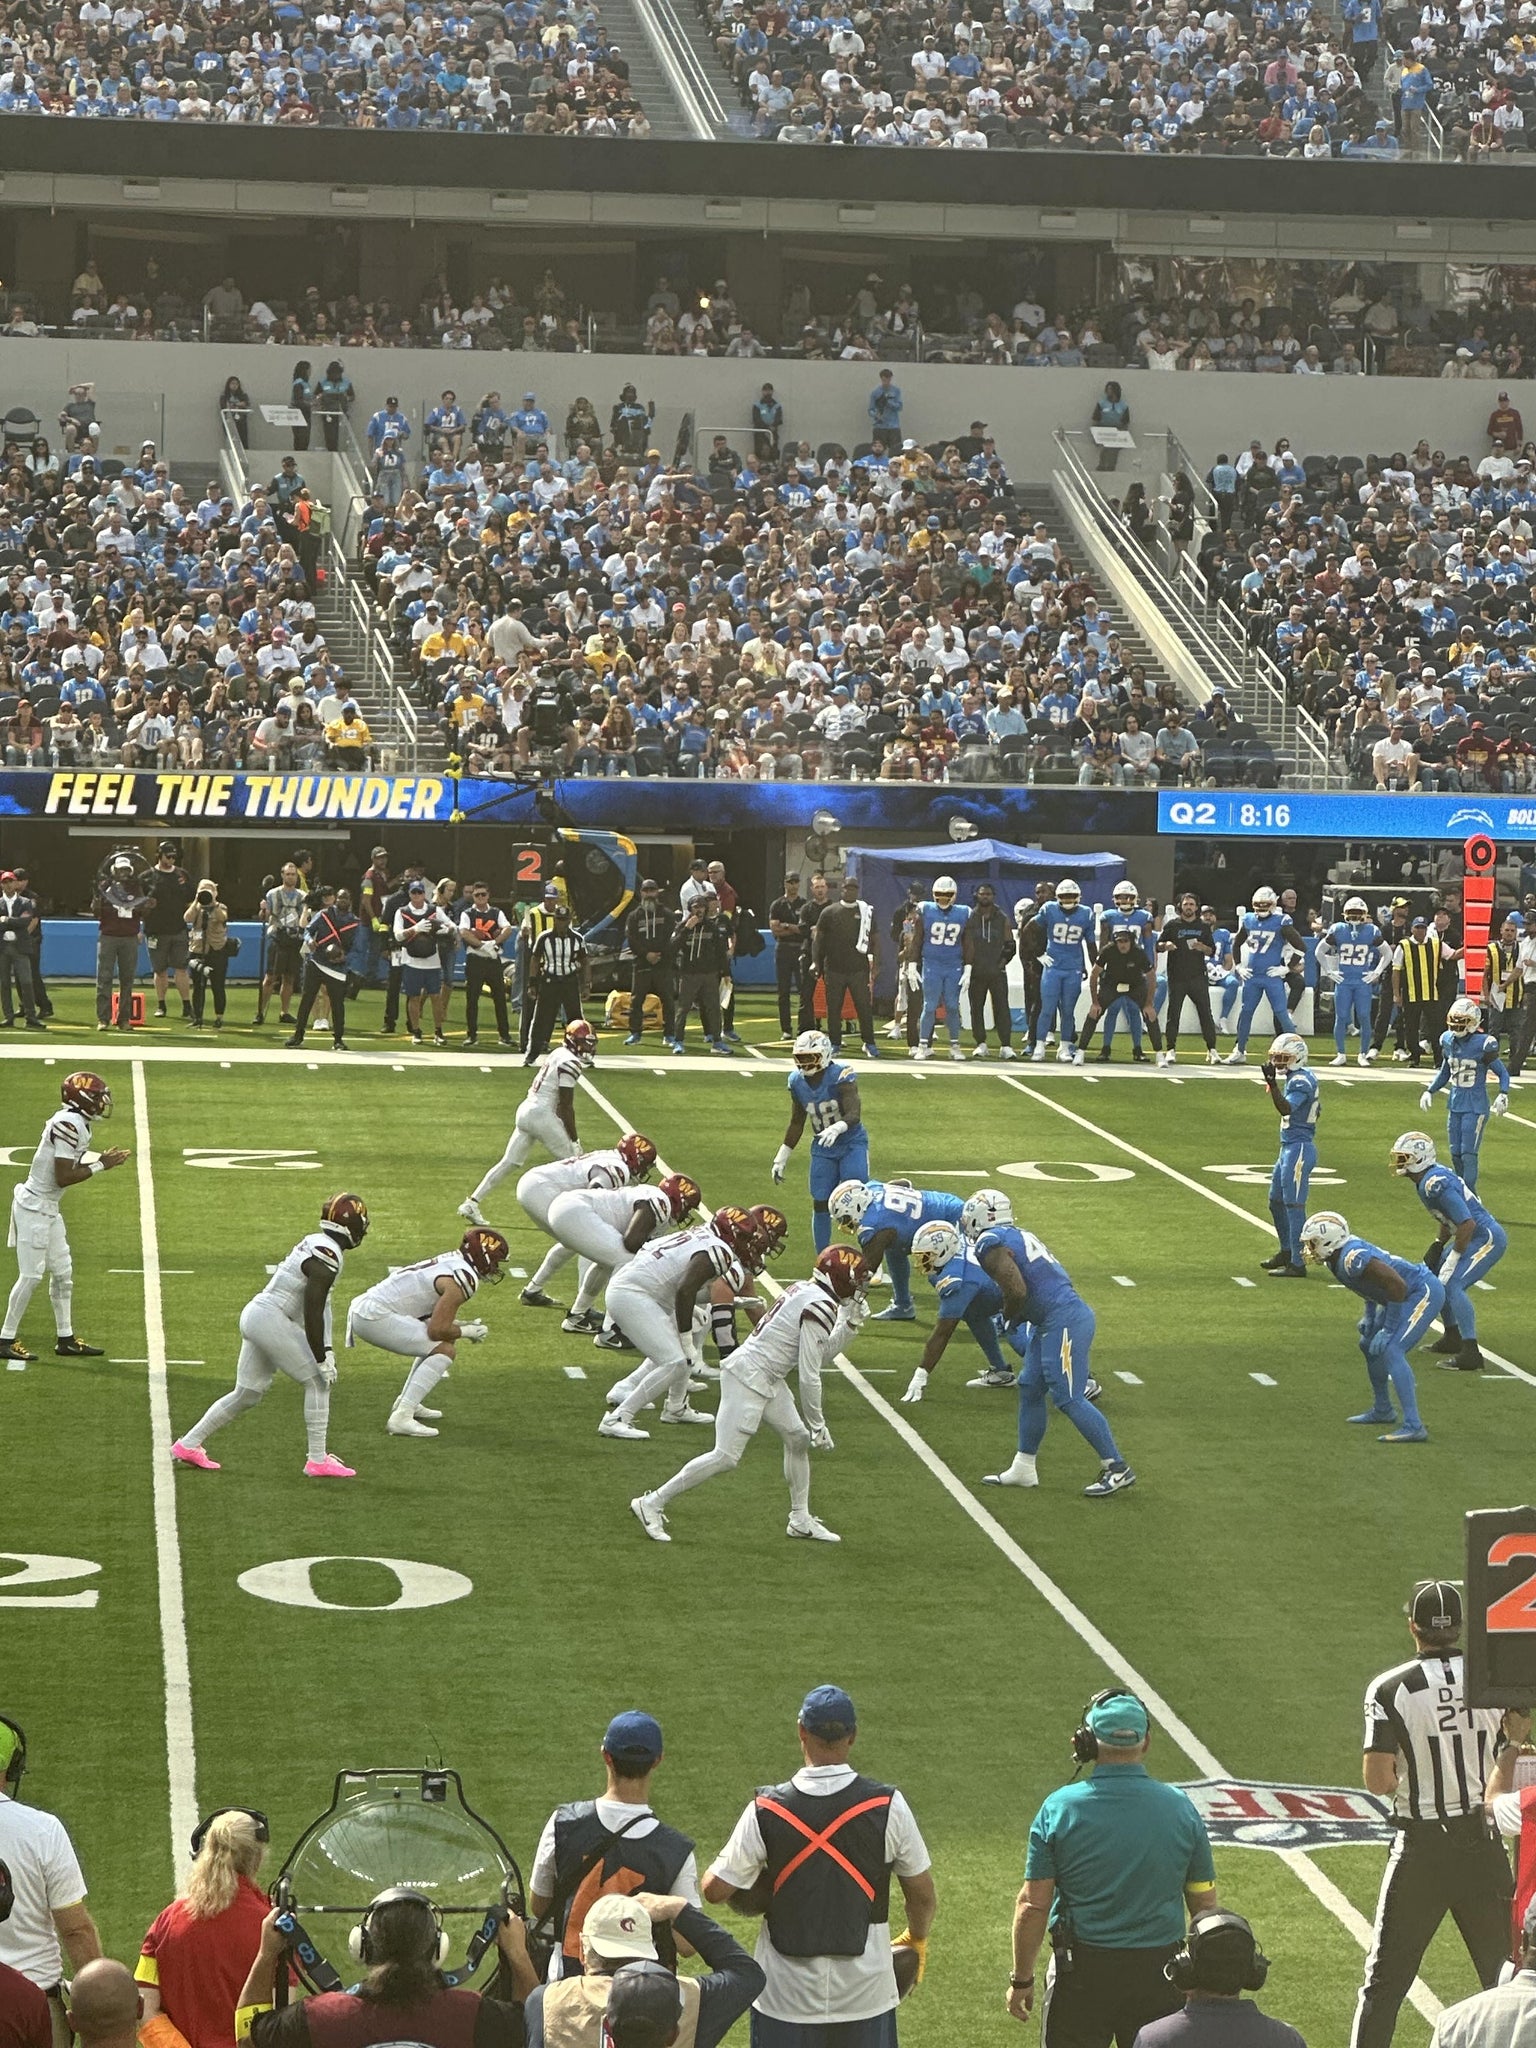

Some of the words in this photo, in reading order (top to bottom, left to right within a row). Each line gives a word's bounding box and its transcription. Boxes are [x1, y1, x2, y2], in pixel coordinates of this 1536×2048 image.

[76, 688, 93, 705] 10
[44, 773, 138, 815] FEEL
[155, 774, 234, 816] THE
[244, 775, 443, 820] THUNDER
[1169, 802, 1217, 825] Q2
[1240, 803, 1291, 828] 8:16
[516, 850, 542, 882] 2
[930, 921, 961, 947] 93
[1052, 922, 1083, 945] 92
[1247, 930, 1276, 954] 57
[1339, 943, 1370, 967] 23
[996, 1161, 1136, 1182] 0
[237, 1555, 474, 1611] 0
[1486, 1532, 1536, 1633] 2
[1436, 1705, 1474, 1732] 21
[1208, 1787, 1371, 1820] NF
